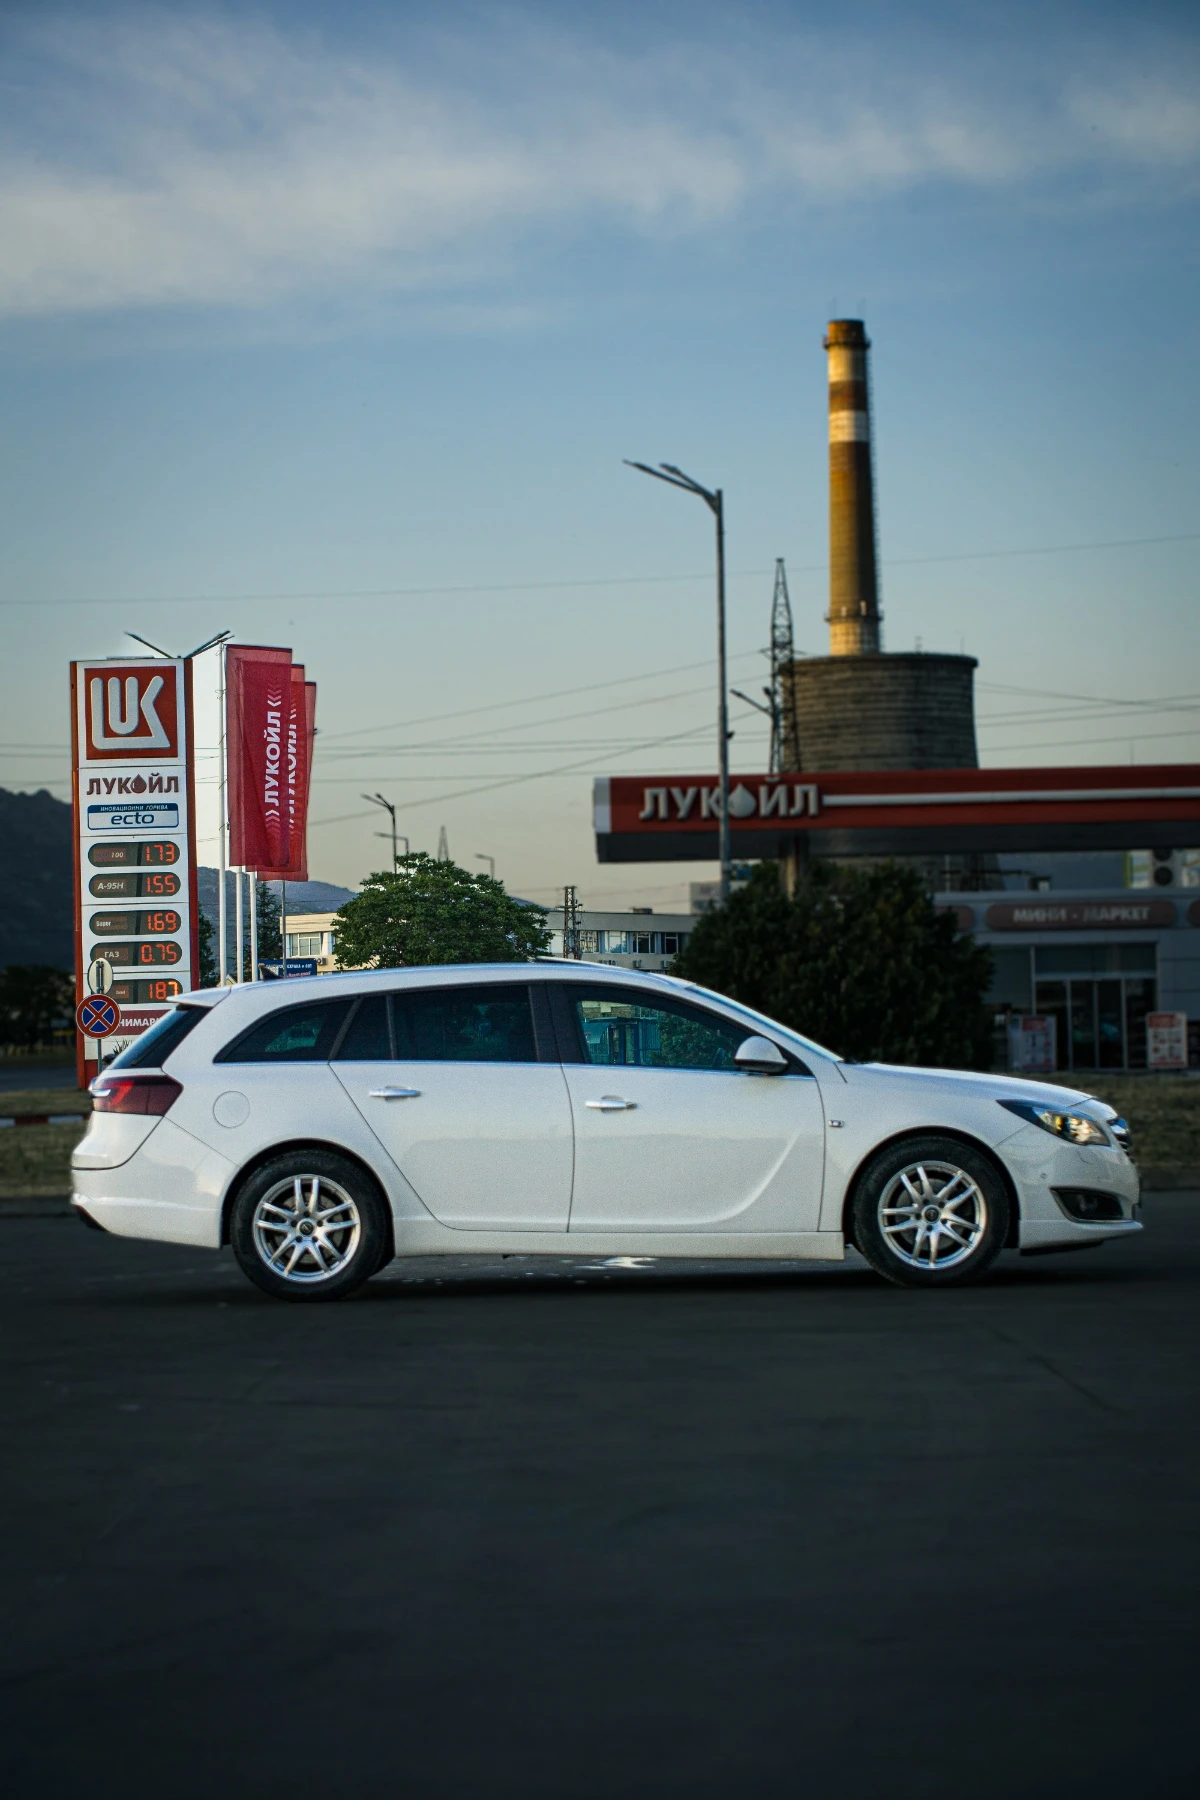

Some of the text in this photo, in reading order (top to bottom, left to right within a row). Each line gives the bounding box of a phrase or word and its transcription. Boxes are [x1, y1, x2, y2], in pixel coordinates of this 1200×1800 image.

[264, 711, 281, 806] ЛУКОЙЛ
[86, 772, 179, 795] ЛУКОЙЛ
[110, 812, 155, 825] ecto
[145, 843, 176, 863] 1.73
[146, 874, 176, 894] 1.55
[147, 912, 177, 932] 1.69
[141, 943, 177, 963] 0.75
